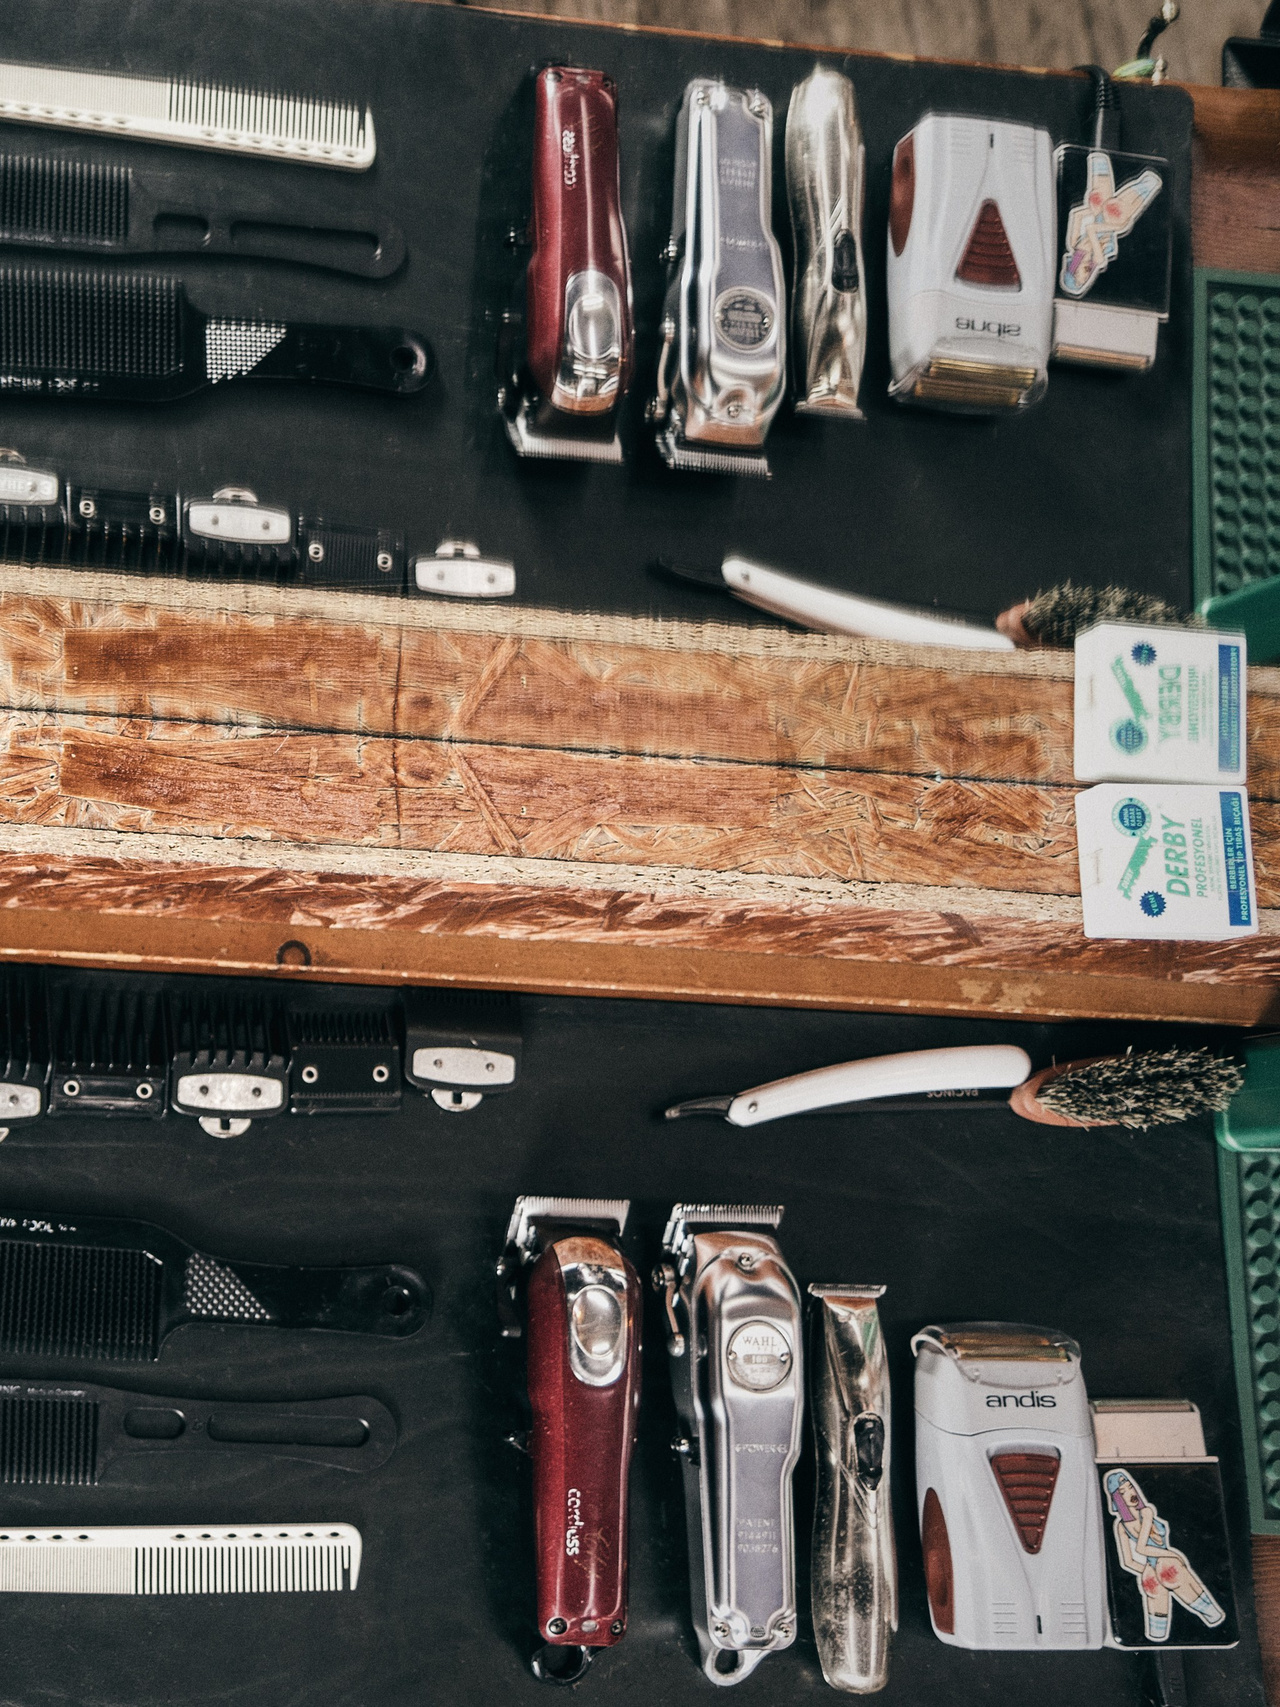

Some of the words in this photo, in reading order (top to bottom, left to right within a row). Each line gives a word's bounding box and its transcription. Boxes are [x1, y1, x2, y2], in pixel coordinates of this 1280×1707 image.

[1224, 827, 1235, 846] İÇİN
[1235, 827, 1244, 850] TIRAŞ
[1160, 813, 1191, 898] DERBY
[1191, 817, 1209, 898] PROFESYONEL
[1226, 846, 1237, 890] BERBERLER
[1238, 864, 1249, 921] PROFESYONEL
[743, 1336, 778, 1347] WAHL
[985, 1390, 1057, 1408] andis
